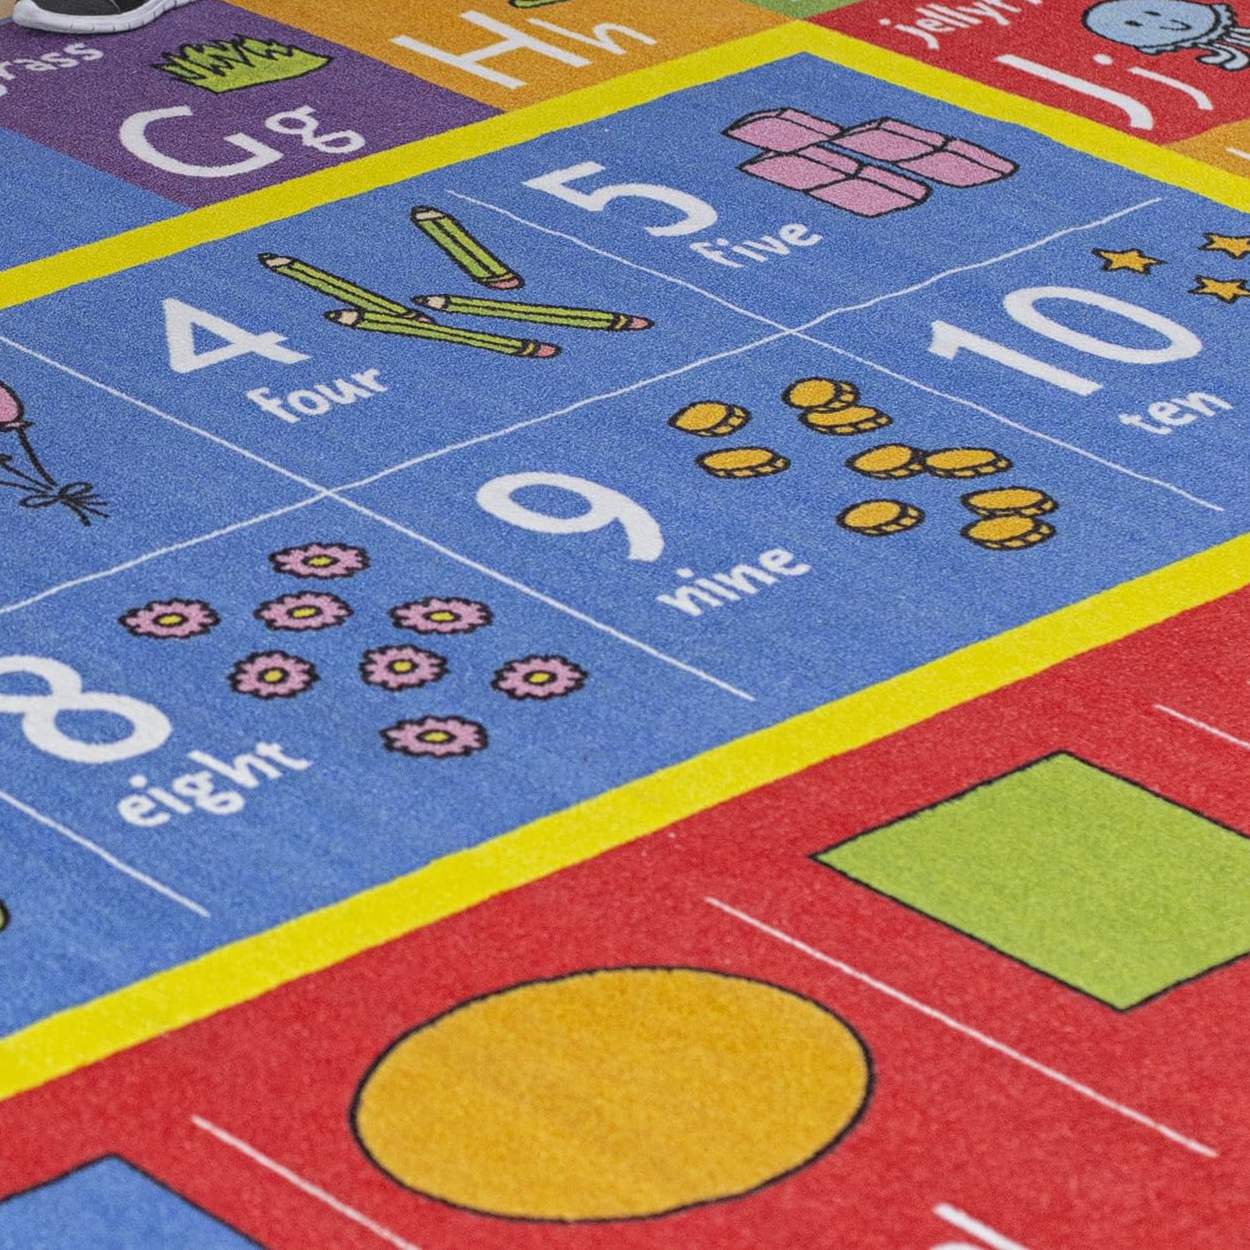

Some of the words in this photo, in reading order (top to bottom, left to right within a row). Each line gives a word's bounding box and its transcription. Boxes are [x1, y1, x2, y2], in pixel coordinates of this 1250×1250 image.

[390, 10, 657, 90] Hh
[996, 53, 1213, 130] Jj
[119, 105, 366, 178] Gg
[522, 161, 719, 237] 5
[689, 221, 823, 269] five
[162, 297, 311, 374] 4
[927, 285, 1203, 396] 10
[246, 368, 389, 424] four
[1118, 388, 1234, 436] ten
[476, 471, 666, 562] 9
[656, 548, 812, 617] nine
[116, 741, 313, 828] eight
